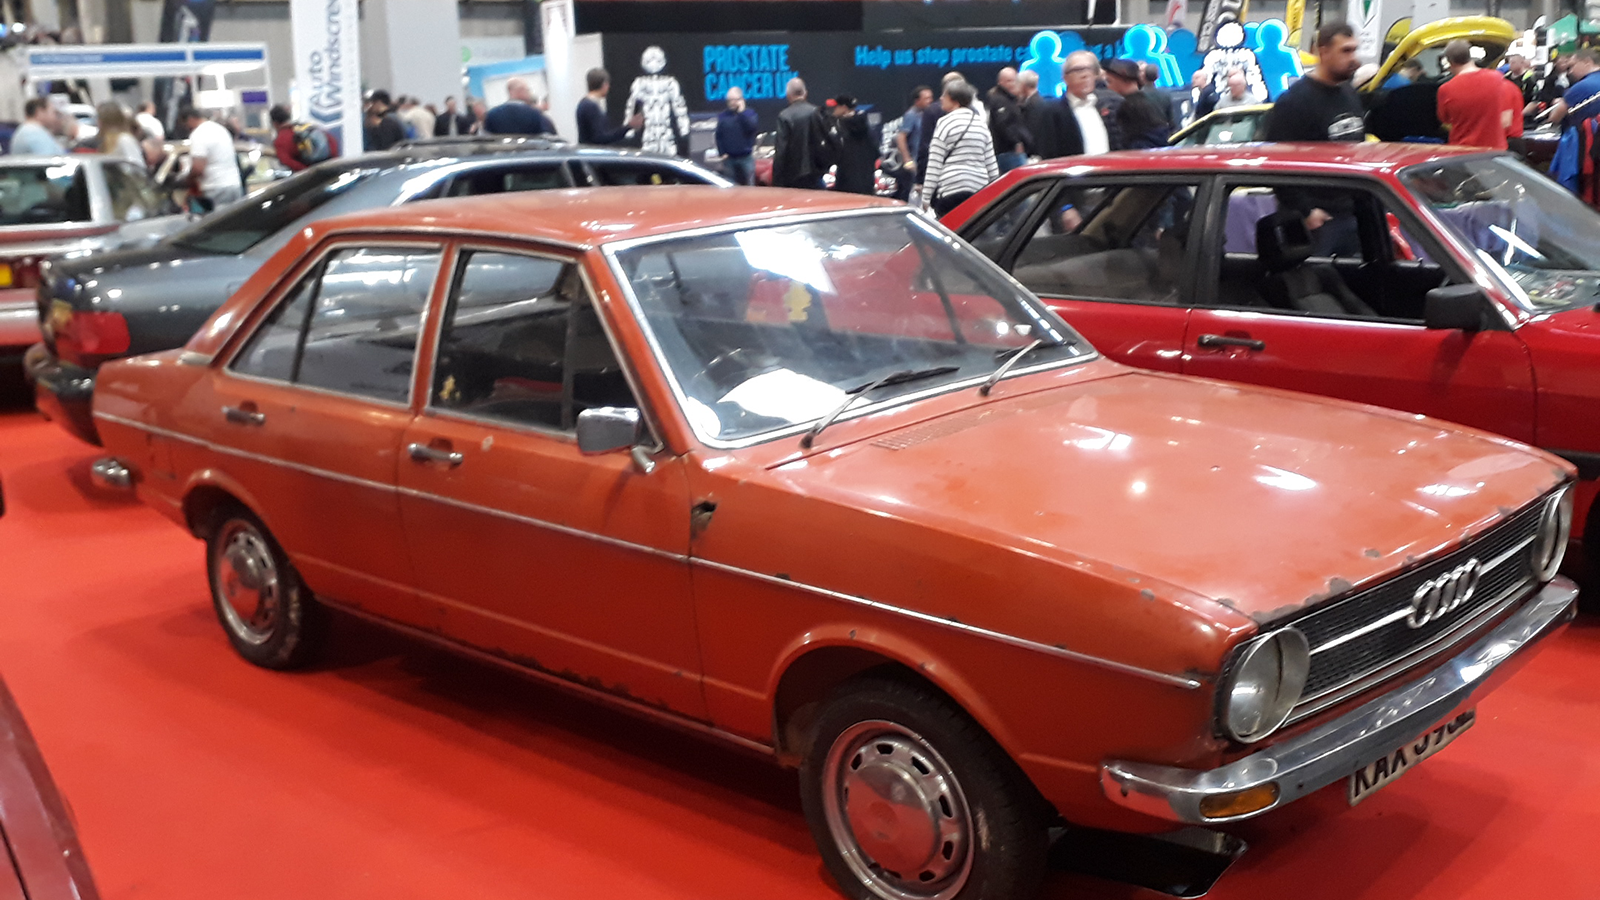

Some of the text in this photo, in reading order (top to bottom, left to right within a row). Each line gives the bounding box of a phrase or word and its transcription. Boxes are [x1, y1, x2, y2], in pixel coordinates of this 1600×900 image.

[703, 44, 790, 74] PROSTATE
[855, 45, 892, 69] Help
[894, 48, 914, 66] us
[915, 45, 949, 68] stop
[950, 44, 1013, 67] prostate
[308, 50, 322, 107] Auto
[705, 71, 774, 101] CANCER
